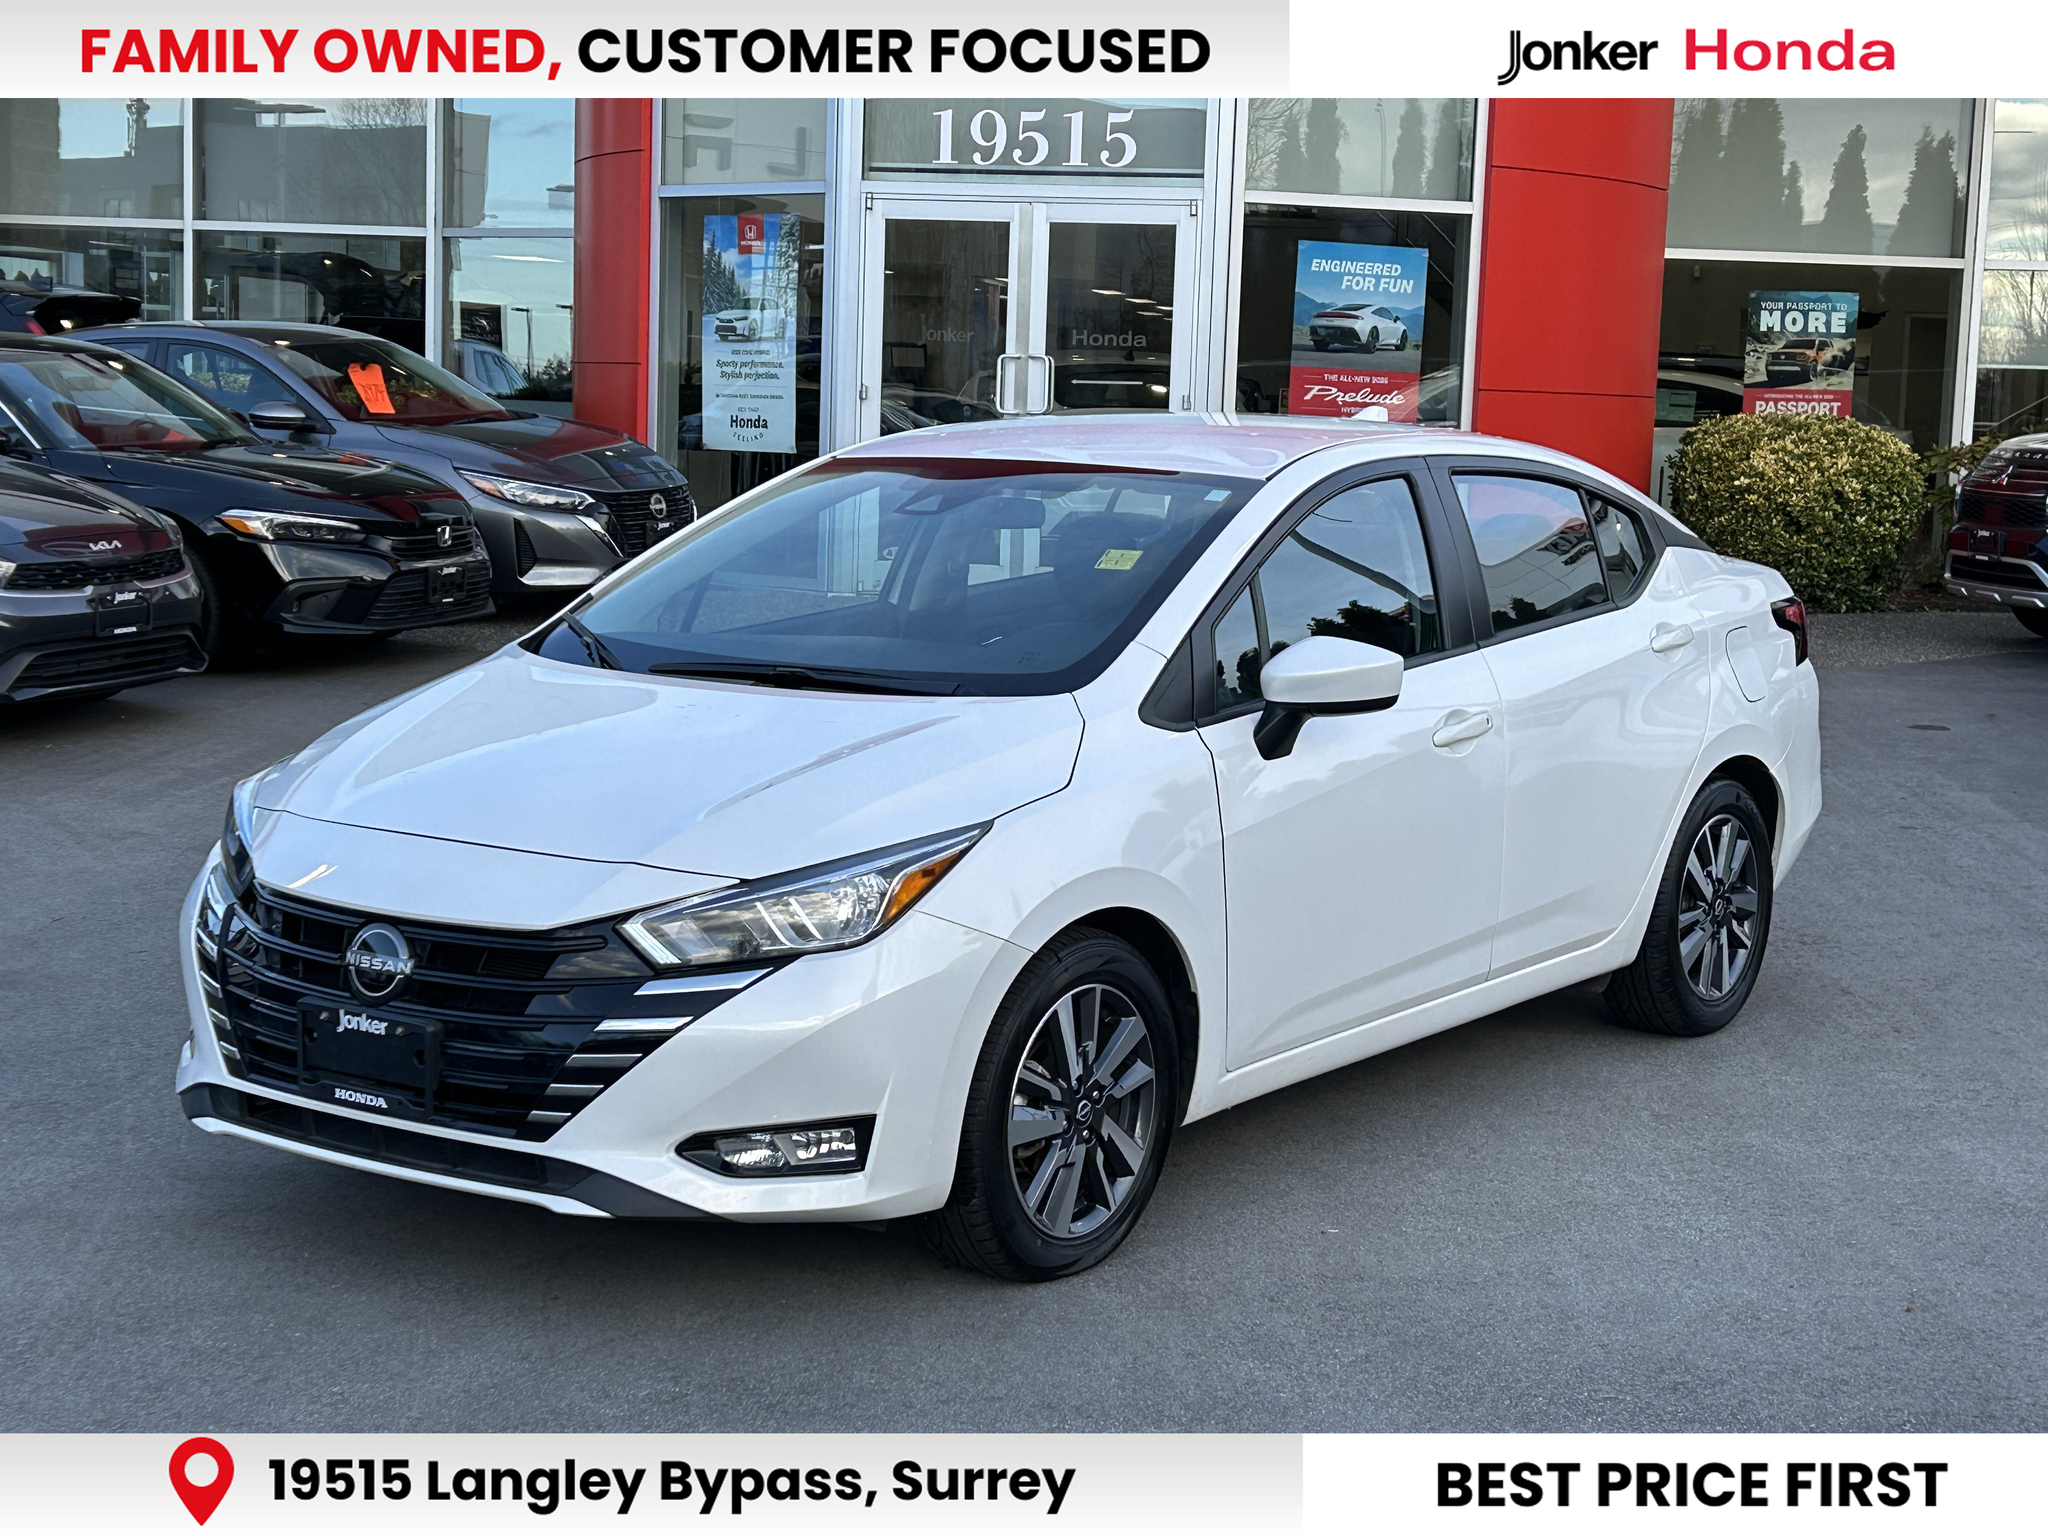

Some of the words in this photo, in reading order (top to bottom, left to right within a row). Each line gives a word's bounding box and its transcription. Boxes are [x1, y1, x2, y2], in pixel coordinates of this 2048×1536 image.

[932, 108, 1138, 168] 19515
[1310, 258, 1402, 276] ENGINEERED
[1341, 275, 1376, 292] FOR
[1378, 278, 1414, 294] FUN
[1760, 301, 1784, 310] YOUR
[1786, 301, 1832, 311] PASSPORT
[1835, 302, 1848, 311] TO
[918, 312, 974, 347] Jonker
[1759, 309, 1847, 334] MORE
[1071, 329, 1148, 348] Honda
[1303, 384, 1406, 405] Prelude
[1755, 400, 1842, 418] PASSPORT
[730, 414, 769, 430] Honda
[345, 949, 415, 975] NISSAN
[336, 1008, 389, 1036] Jonker
[334, 1087, 388, 1109] HONDA
